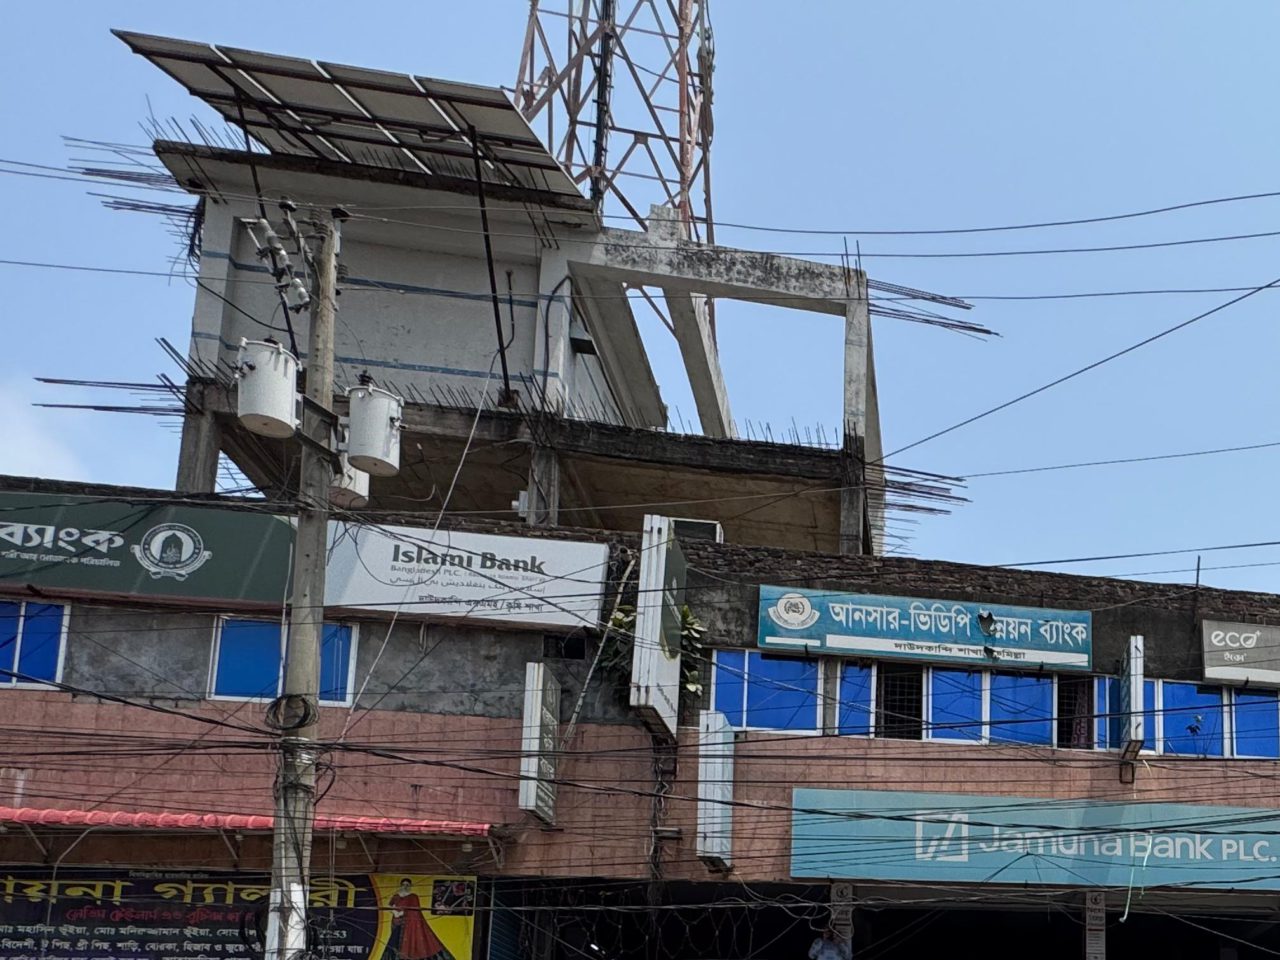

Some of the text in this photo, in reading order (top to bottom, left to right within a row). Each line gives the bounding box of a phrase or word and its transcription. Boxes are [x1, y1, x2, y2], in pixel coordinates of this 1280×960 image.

[391, 544, 547, 575] Islami Bank
[828, 602, 971, 638] আনসার-ভিডিপি
[1038, 618, 1087, 648] ব্যাংক
[975, 824, 1278, 863] Jamuna Bank PLC.
